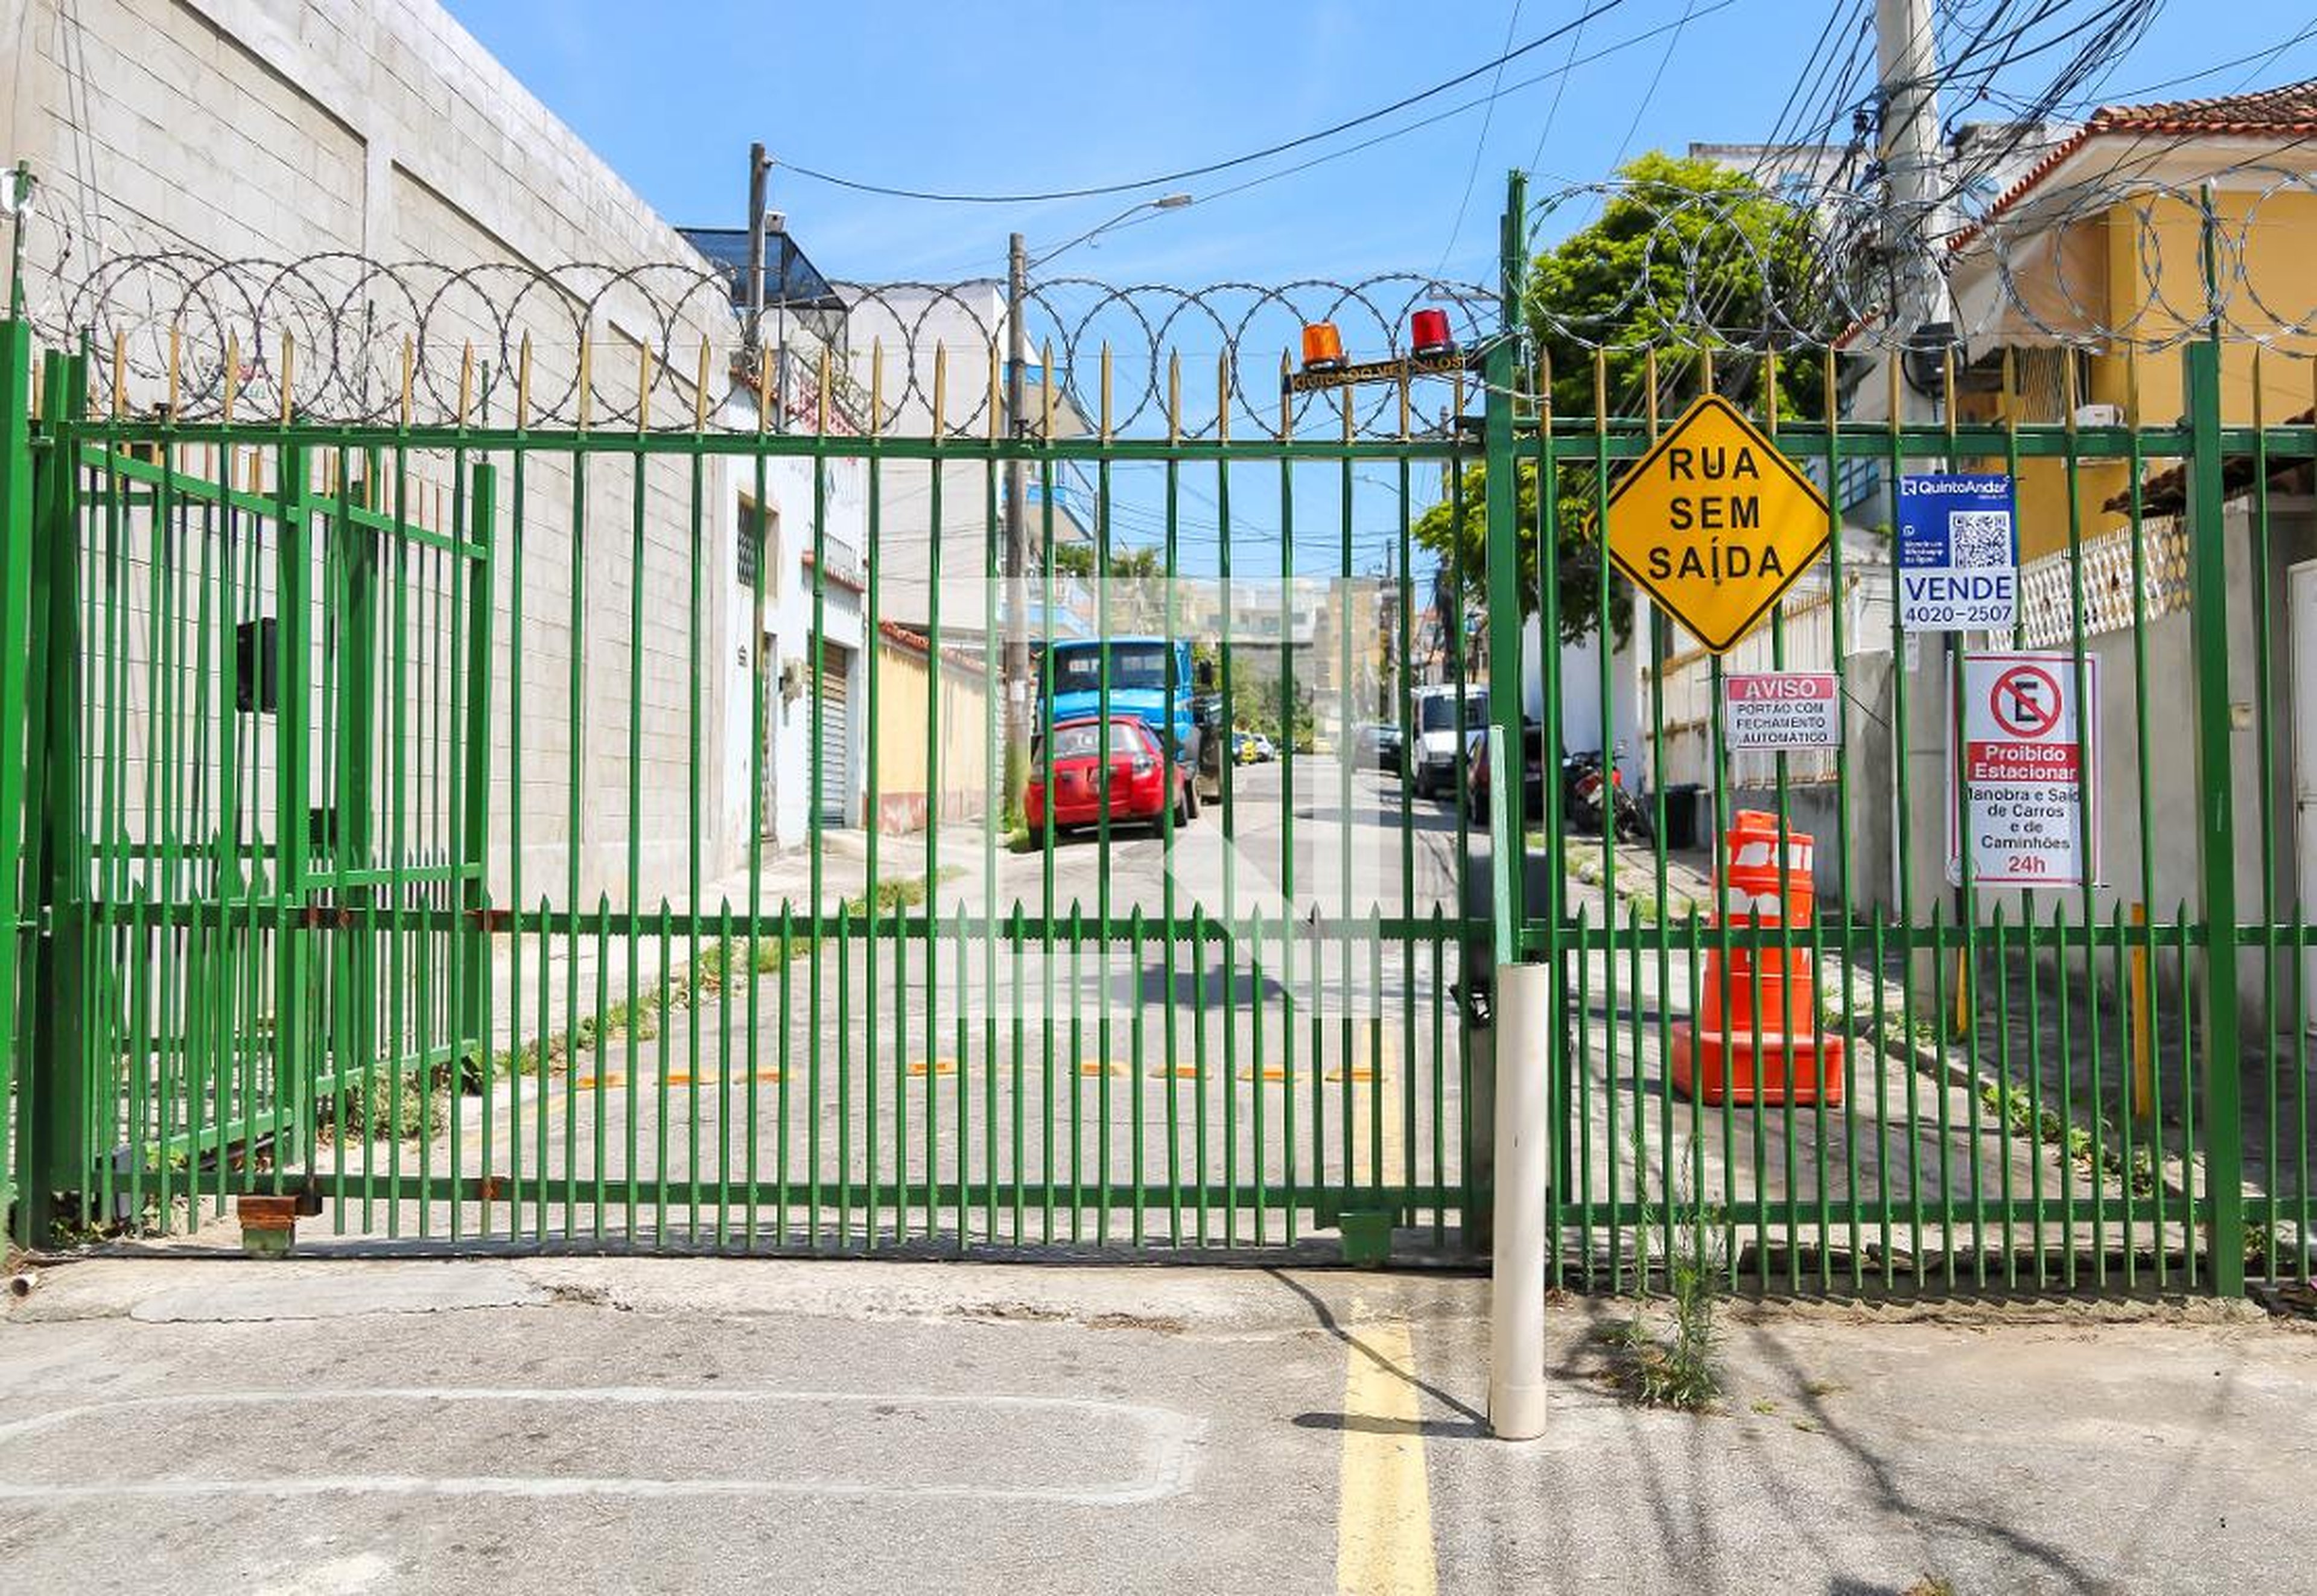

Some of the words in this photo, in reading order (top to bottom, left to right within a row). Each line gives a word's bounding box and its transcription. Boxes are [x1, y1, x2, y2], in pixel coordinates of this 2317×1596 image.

[1670, 446, 1760, 480] RUA
[1919, 480, 2008, 494] QuintoAndar
[1670, 495, 1760, 530] SEM
[1648, 536, 1785, 580] SAÍDA
[1904, 576, 2012, 601] VENDE
[1905, 605, 2012, 623] 4020-2507
[1745, 679, 1817, 699] AVISO
[1794, 702, 1823, 714] COM
[1737, 716, 1826, 730] FECHAMENTO
[1985, 745, 2067, 761] Proibido
[1975, 763, 2077, 780] Estacionar
[2034, 792, 2044, 802] e
[1988, 804, 2007, 818] de
[2012, 804, 2065, 818] Carros
[2010, 823, 2020, 833] e
[2024, 821, 2044, 833] de
[1981, 835, 2071, 849] Caminhões
[2009, 855, 2045, 873] 24h
